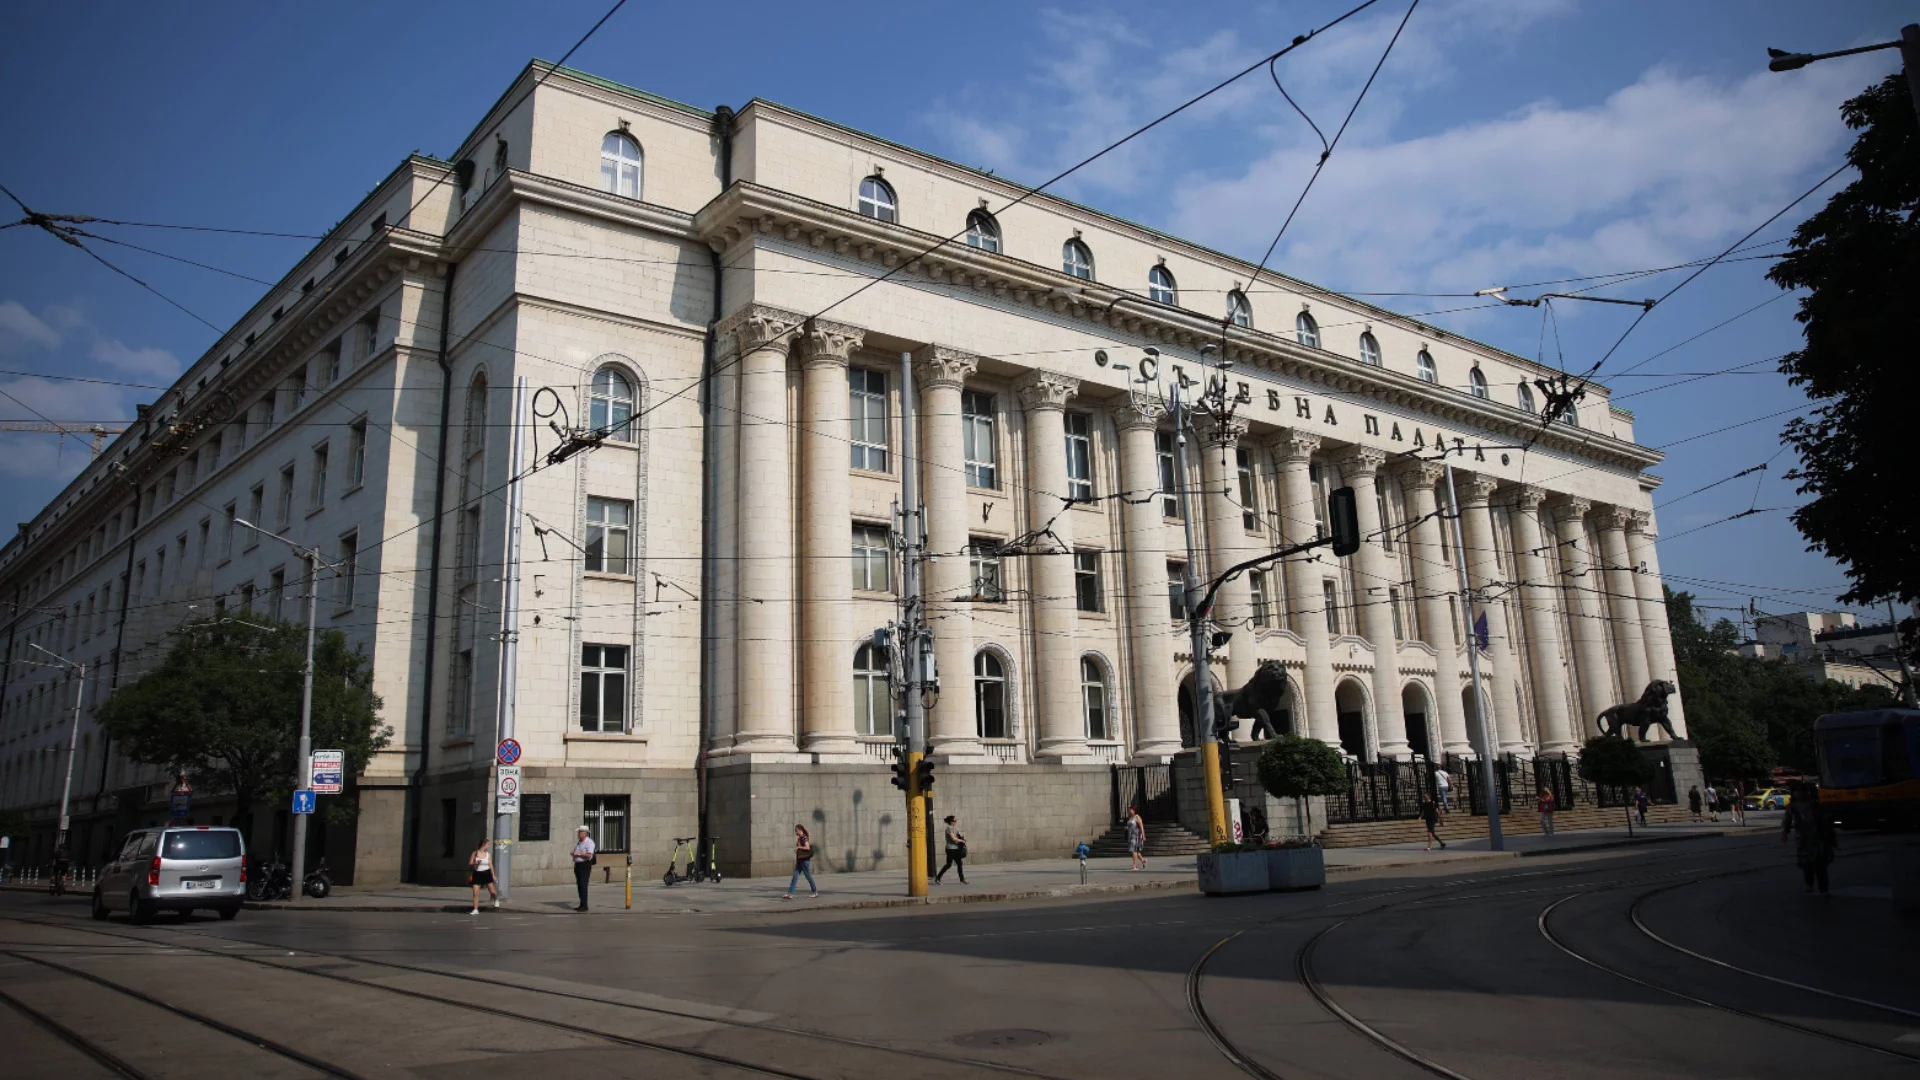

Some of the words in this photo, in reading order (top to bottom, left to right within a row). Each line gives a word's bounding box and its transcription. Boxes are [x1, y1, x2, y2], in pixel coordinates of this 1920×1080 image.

[1139, 357, 1337, 426] СЪДЕБНА
[1364, 413, 1486, 462] ПАЛАТА
[500, 768, 519, 776] ЗОНА
[504, 783, 513, 791] 30
